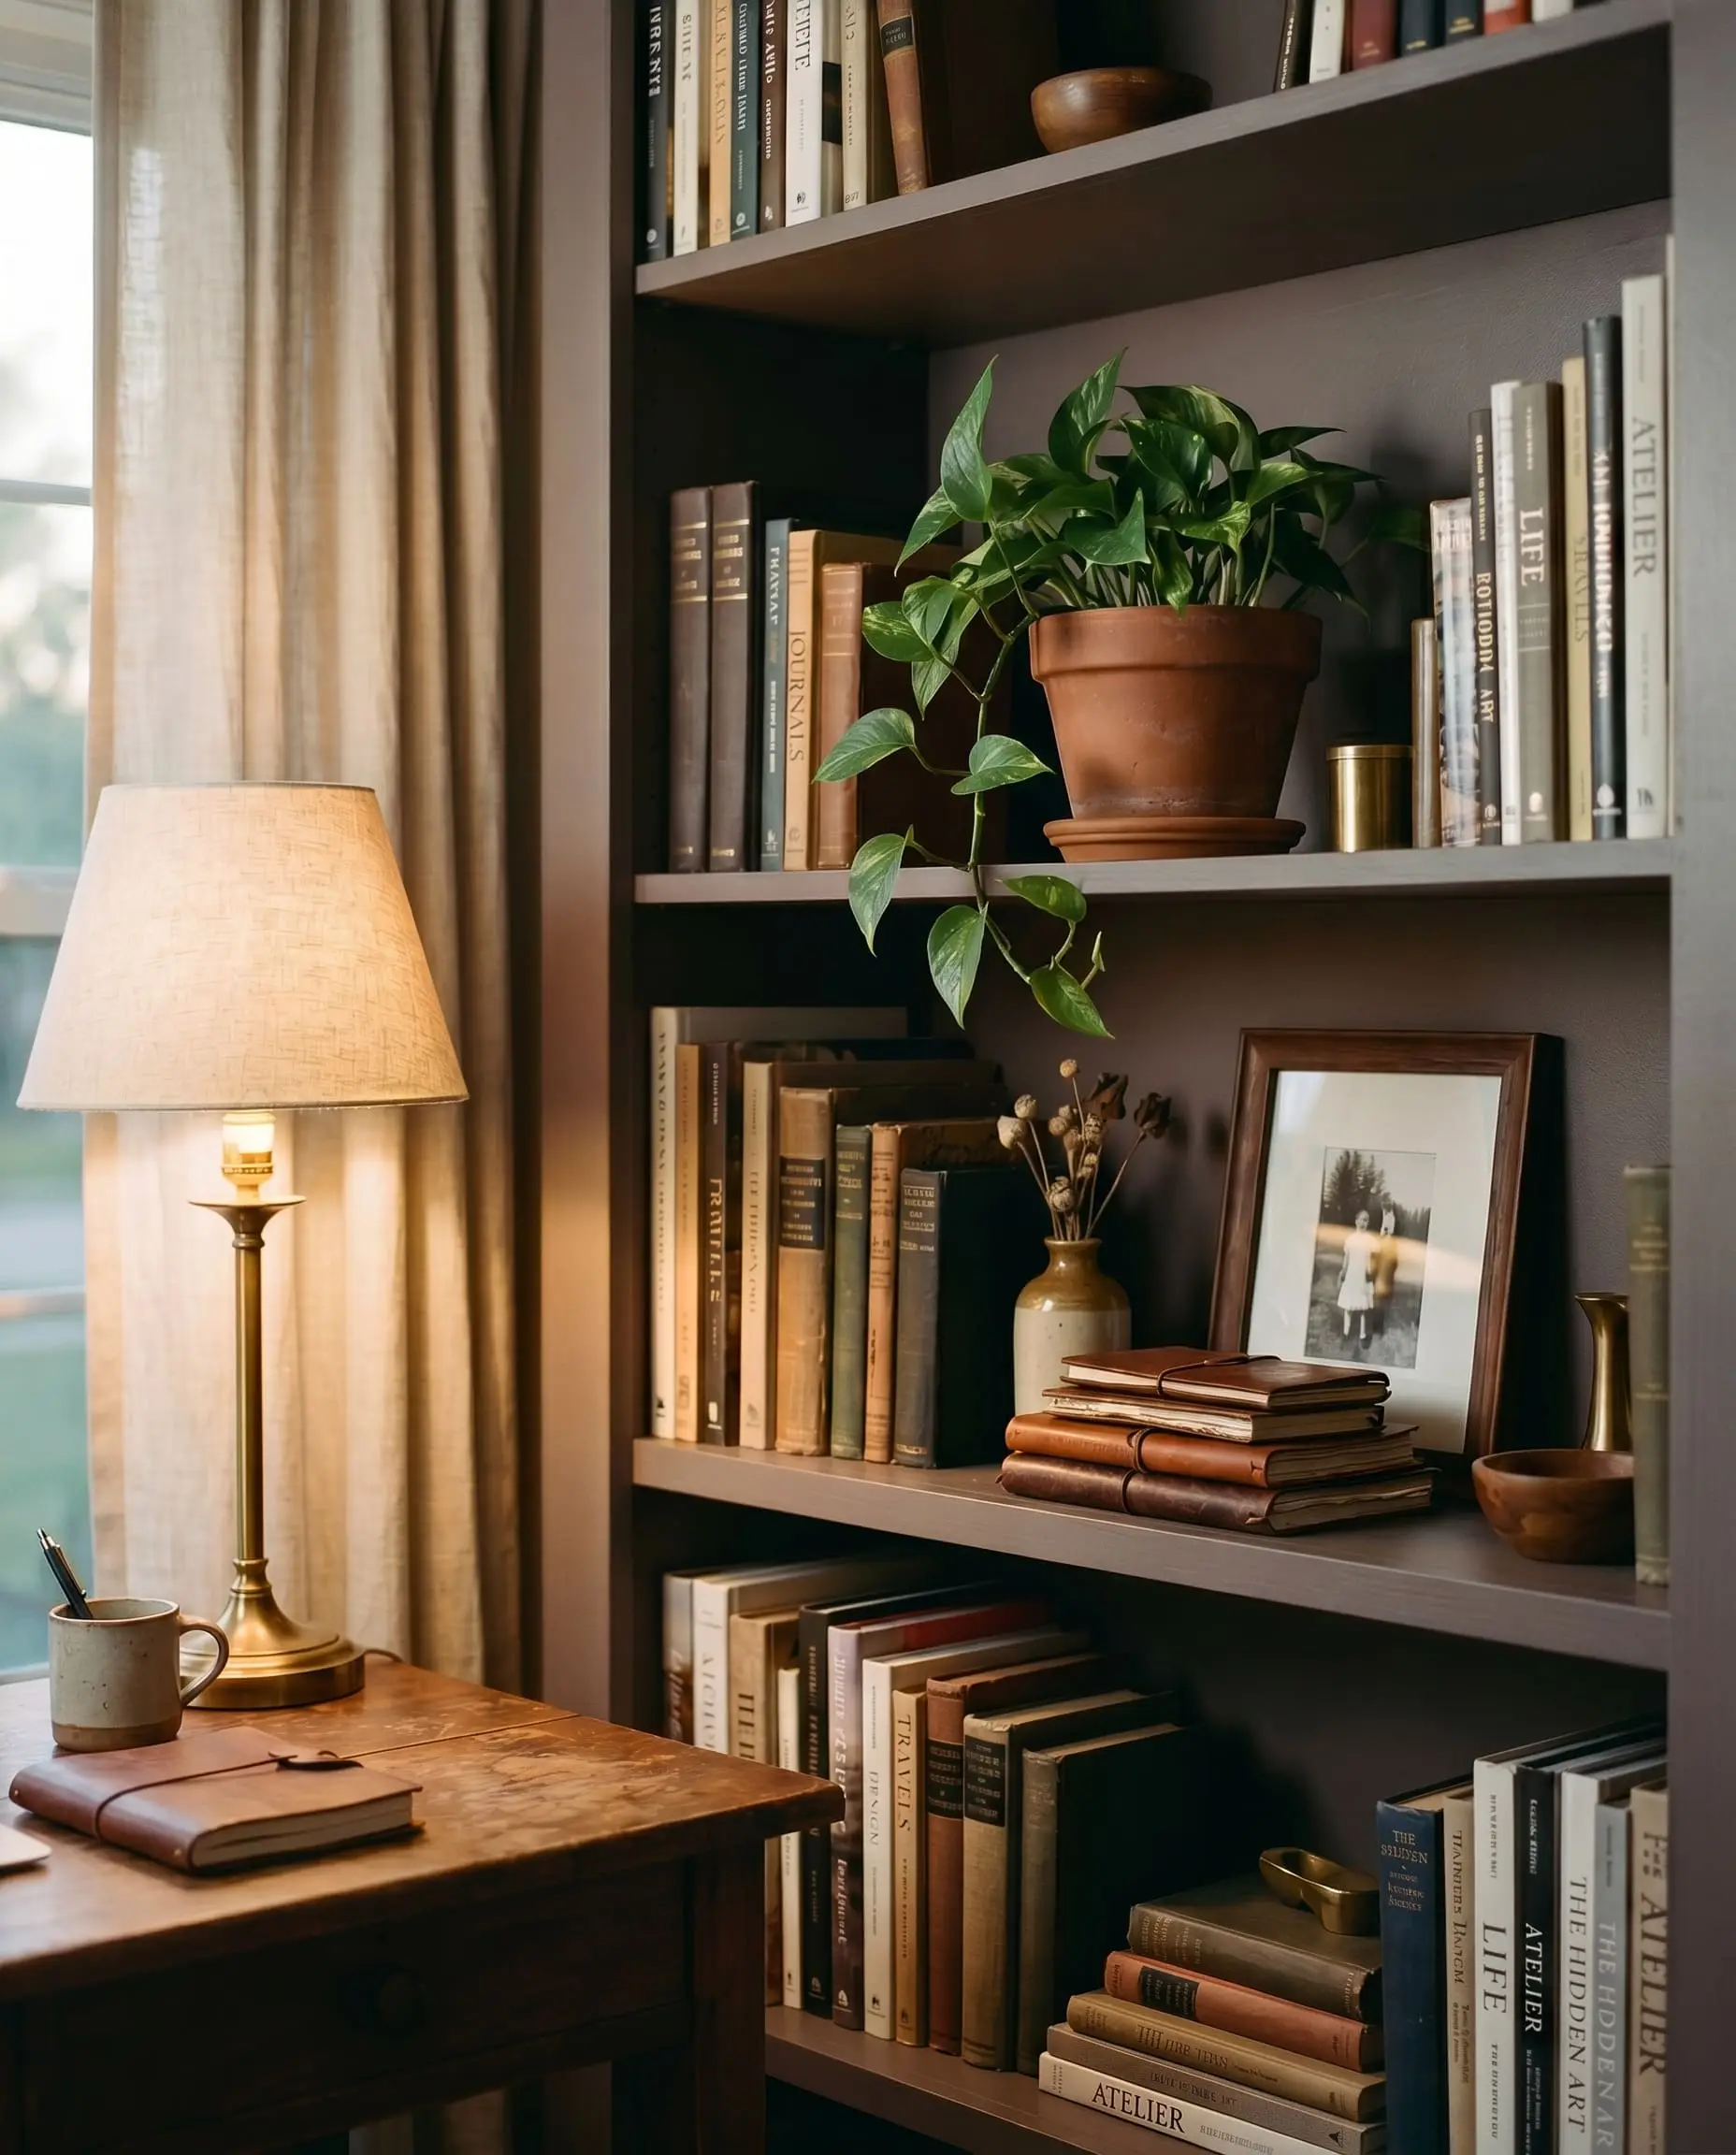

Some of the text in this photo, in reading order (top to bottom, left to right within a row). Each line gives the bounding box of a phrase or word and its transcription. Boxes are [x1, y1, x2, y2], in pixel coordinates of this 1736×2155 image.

[1520, 508, 1544, 587] LIFE
[1632, 417, 1656, 577] ATELIER
[896, 1714, 911, 1832] TRAVELS
[1483, 1922, 1507, 2014] LIFE
[1525, 1922, 1542, 2033] ATELIER
[1599, 1921, 1616, 1974] THE
[1568, 1876, 1587, 2133] THE HIDDEN ART
[1092, 2081, 1185, 2133] ATELIER
